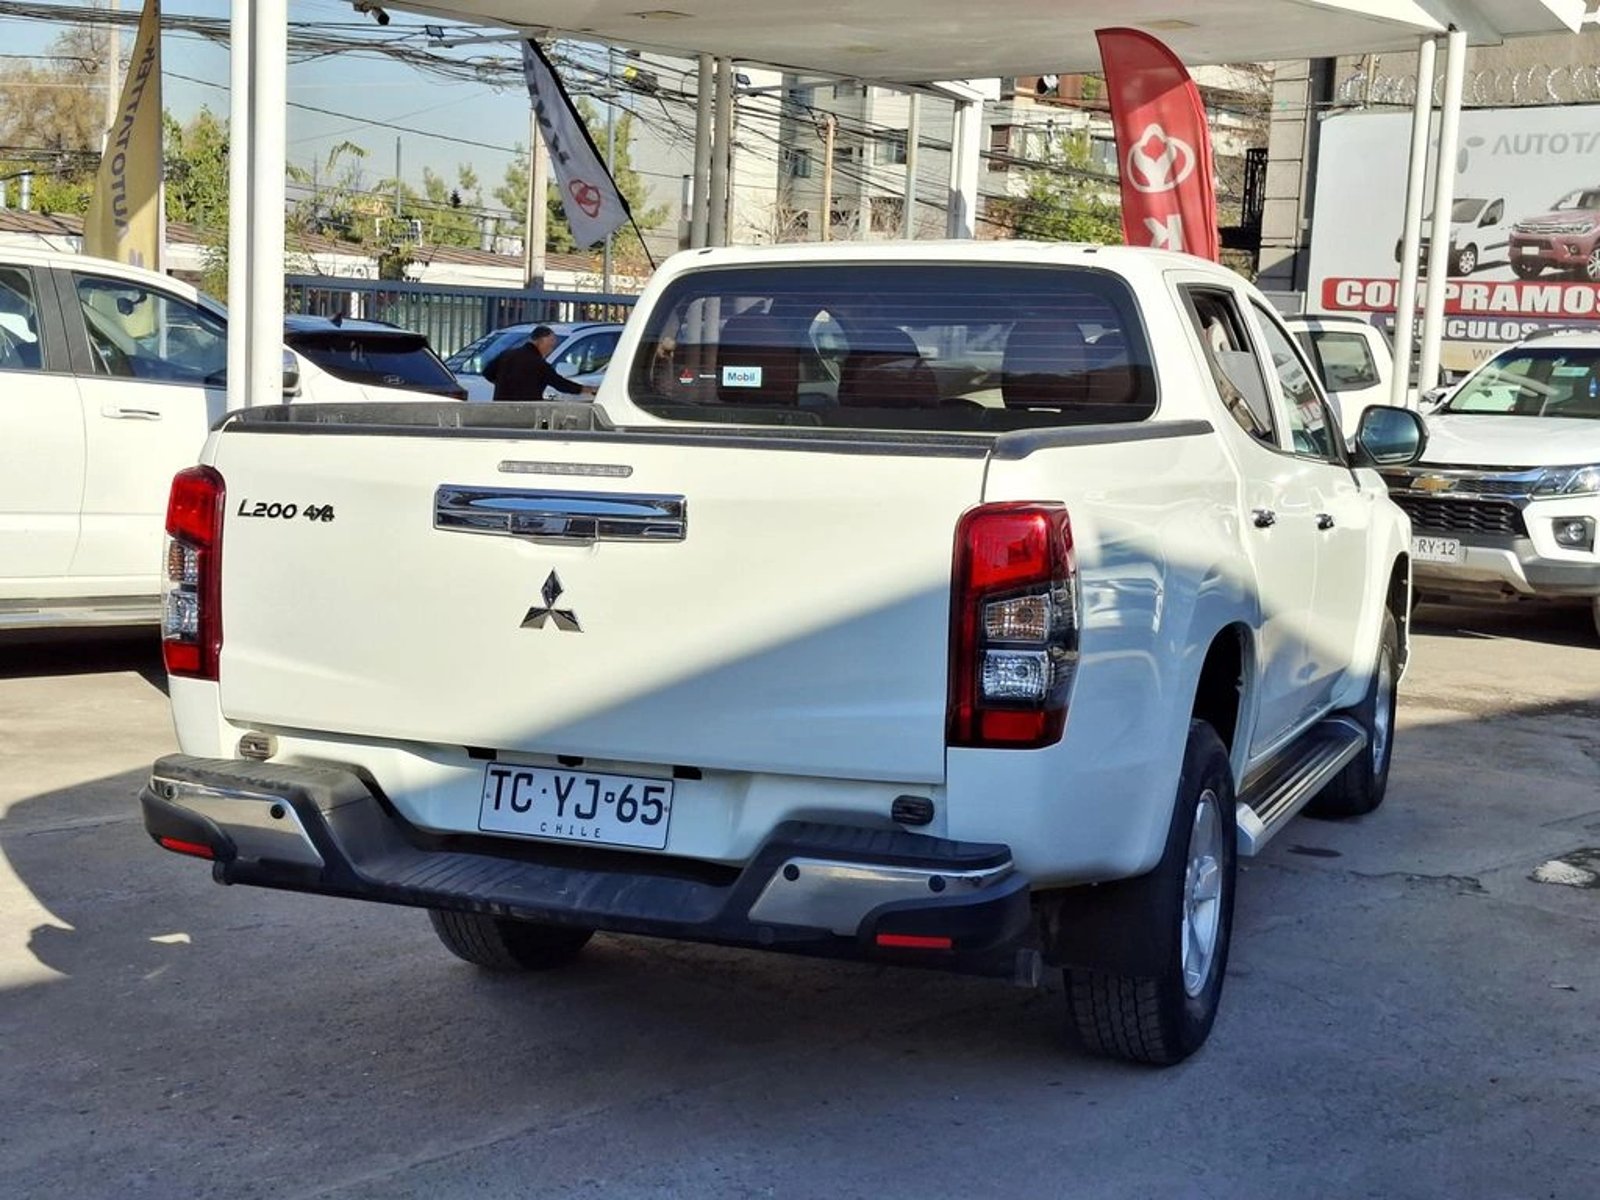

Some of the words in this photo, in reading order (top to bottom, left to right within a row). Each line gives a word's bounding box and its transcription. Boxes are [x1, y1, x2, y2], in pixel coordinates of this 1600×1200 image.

[727, 372, 756, 381] Mobil
[237, 499, 298, 519] L200
[540, 822, 601, 839] CHILE
